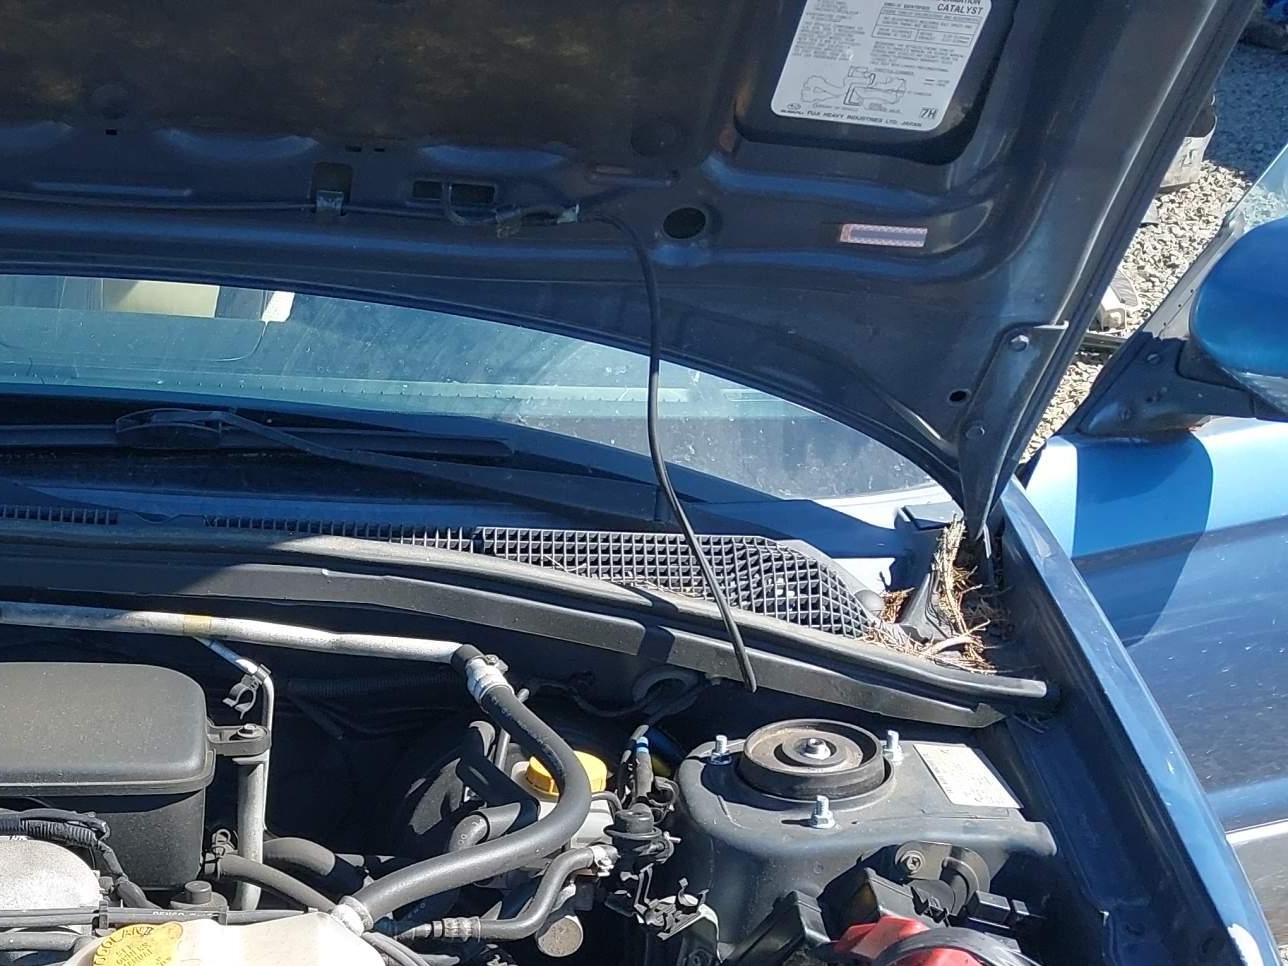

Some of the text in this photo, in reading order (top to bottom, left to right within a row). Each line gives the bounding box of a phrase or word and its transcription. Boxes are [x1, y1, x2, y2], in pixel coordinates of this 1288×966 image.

[937, 3, 984, 15] CATALYST
[823, 111, 845, 119] HEAVY
[920, 107, 938, 119] 7H
